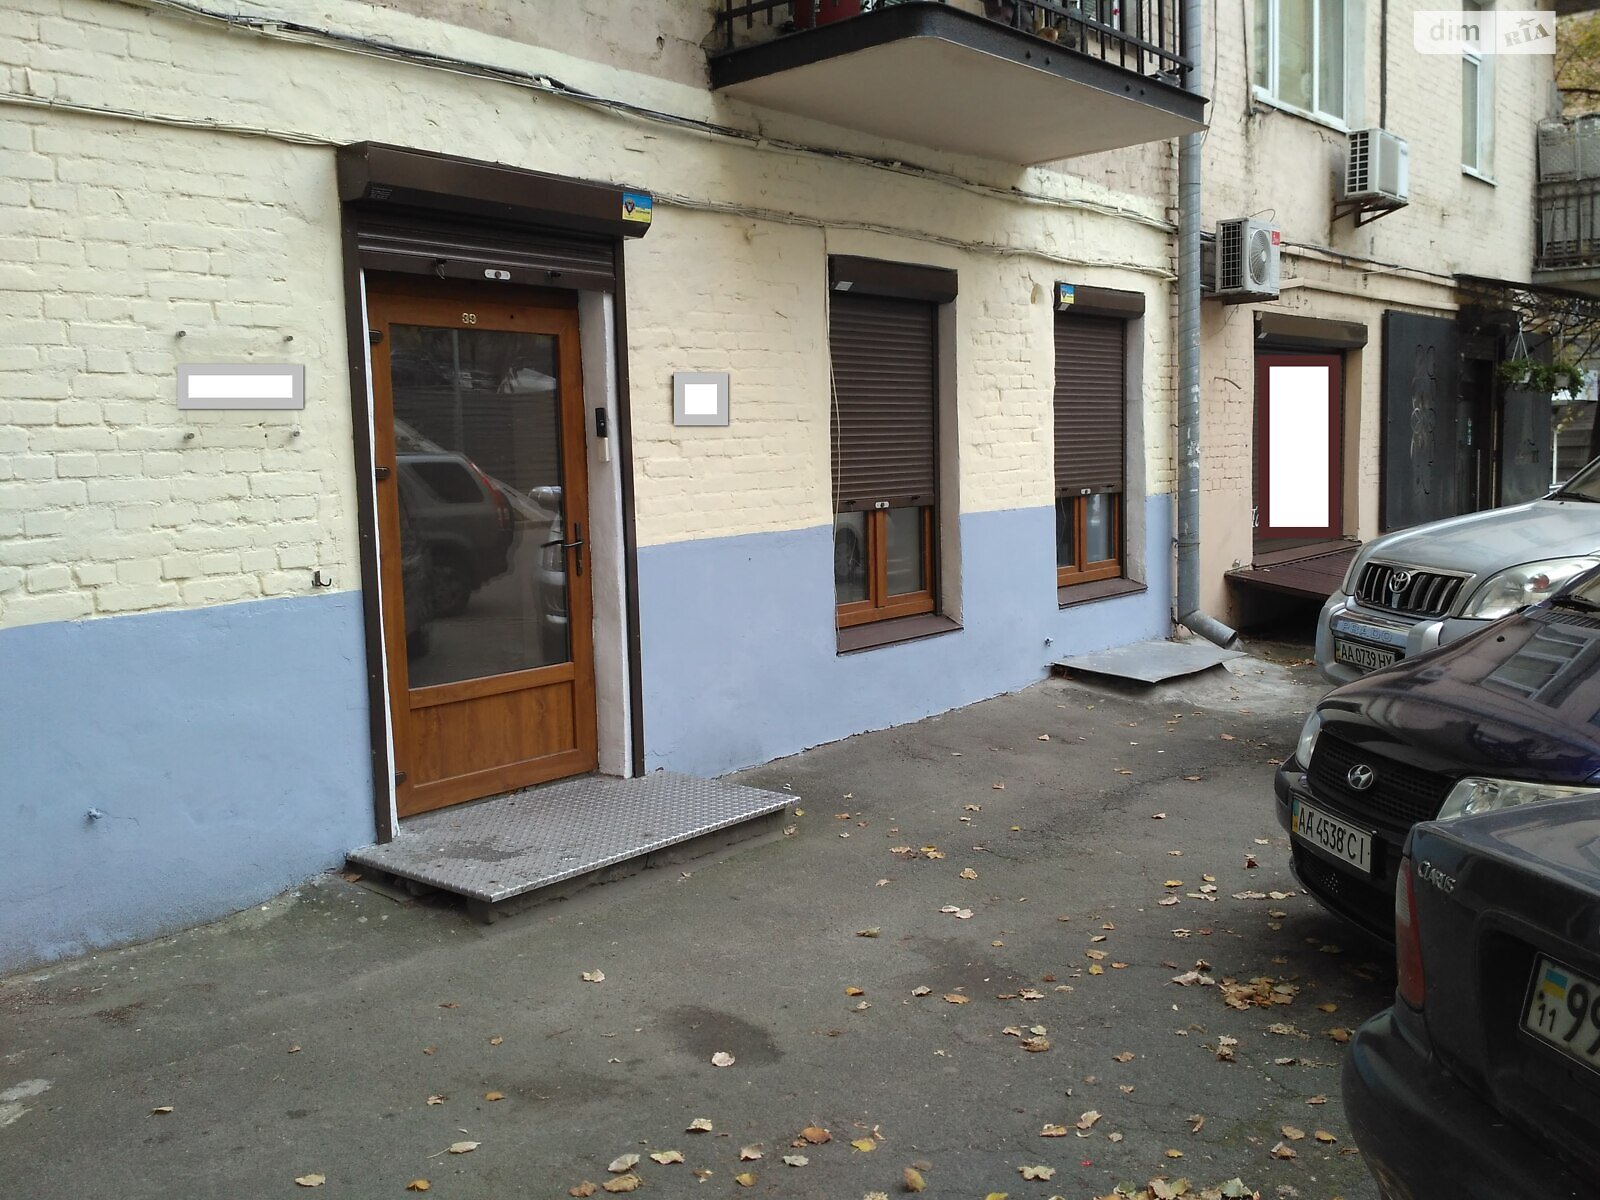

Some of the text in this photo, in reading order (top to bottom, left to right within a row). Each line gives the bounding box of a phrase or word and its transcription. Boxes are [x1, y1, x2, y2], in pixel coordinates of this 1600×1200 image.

[1355, 647, 1376, 667] 0739
[1299, 807, 1315, 838] AA
[1316, 817, 1346, 854] 4538
